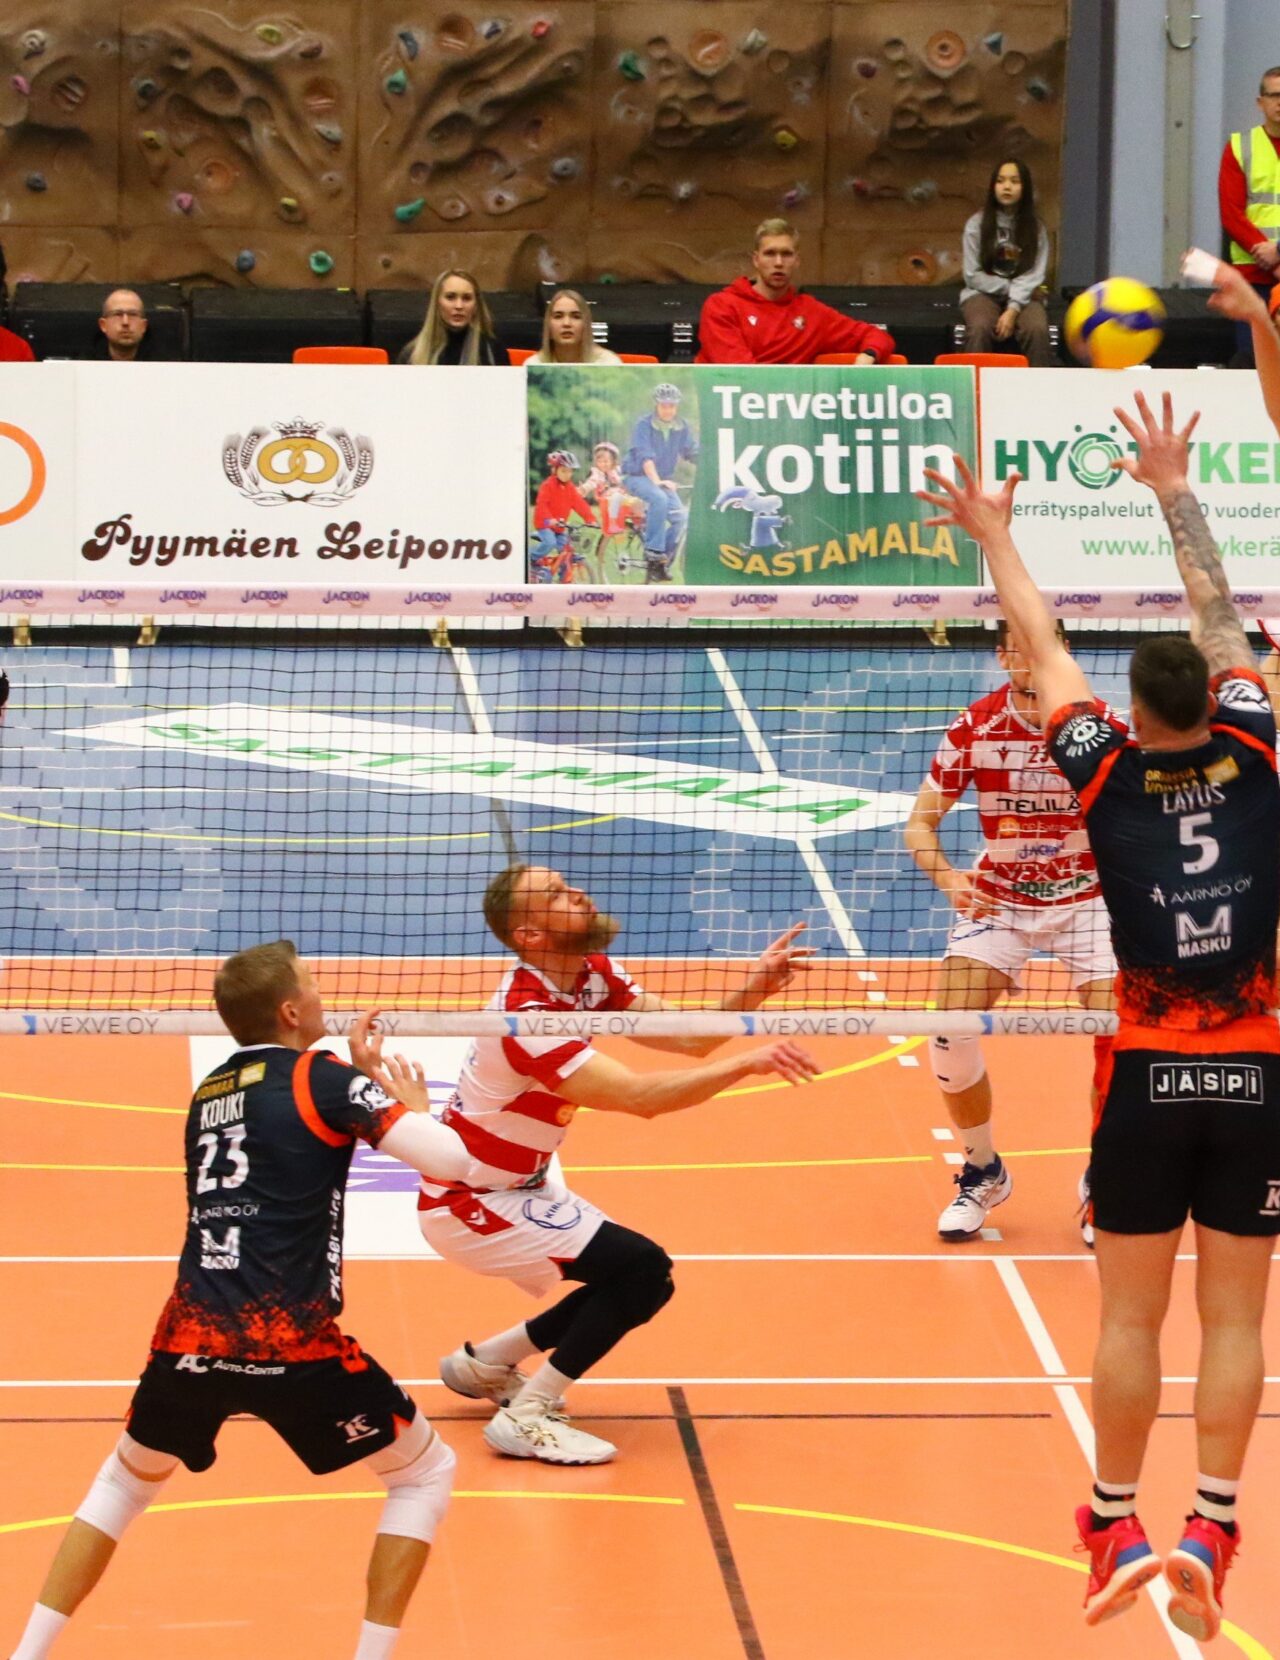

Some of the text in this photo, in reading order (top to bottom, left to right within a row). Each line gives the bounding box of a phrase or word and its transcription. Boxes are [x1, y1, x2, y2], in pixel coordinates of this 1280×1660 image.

[712, 384, 954, 421] Tervetuloa
[716, 427, 958, 495] kotiin
[1012, 500, 1155, 521] errätyspalvelut
[80, 513, 513, 569] Pyymäen Leipomo
[718, 521, 960, 578] SASTAMALA
[78, 590, 125, 603] JACKON
[159, 590, 207, 603] JACKON
[241, 590, 288, 603] JACKON
[323, 591, 370, 604] JACKON
[405, 592, 452, 605] JACKON
[486, 592, 533, 606] JACKON
[568, 593, 614, 606] JACKON
[650, 594, 697, 607] JACKON
[731, 594, 778, 607] JACKON
[812, 594, 859, 607] JACKON
[893, 594, 940, 607] JACKON
[1054, 594, 1101, 607] JACKON
[1135, 594, 1182, 607] JACKON
[1233, 594, 1263, 605] CKON
[147, 722, 873, 825] SASTAMALA
[996, 794, 1082, 814] TELILÄ
[1179, 812, 1220, 875] 5
[1171, 883, 1231, 904] AARNIO
[1234, 875, 1254, 893] OY
[1177, 935, 1232, 959] MASKU
[43, 1016, 121, 1034] VEXVE
[127, 1016, 160, 1034] OY
[525, 1017, 602, 1035] VEXVE
[607, 1017, 640, 1035] OY
[761, 1018, 838, 1035] VEXVE
[843, 1017, 876, 1035] OY
[999, 1017, 1077, 1035] VEXVE
[1081, 1017, 1114, 1035] OY
[201, 1091, 245, 1130] KOUKI
[196, 1124, 250, 1195] 23
[174, 1353, 210, 1374] AC
